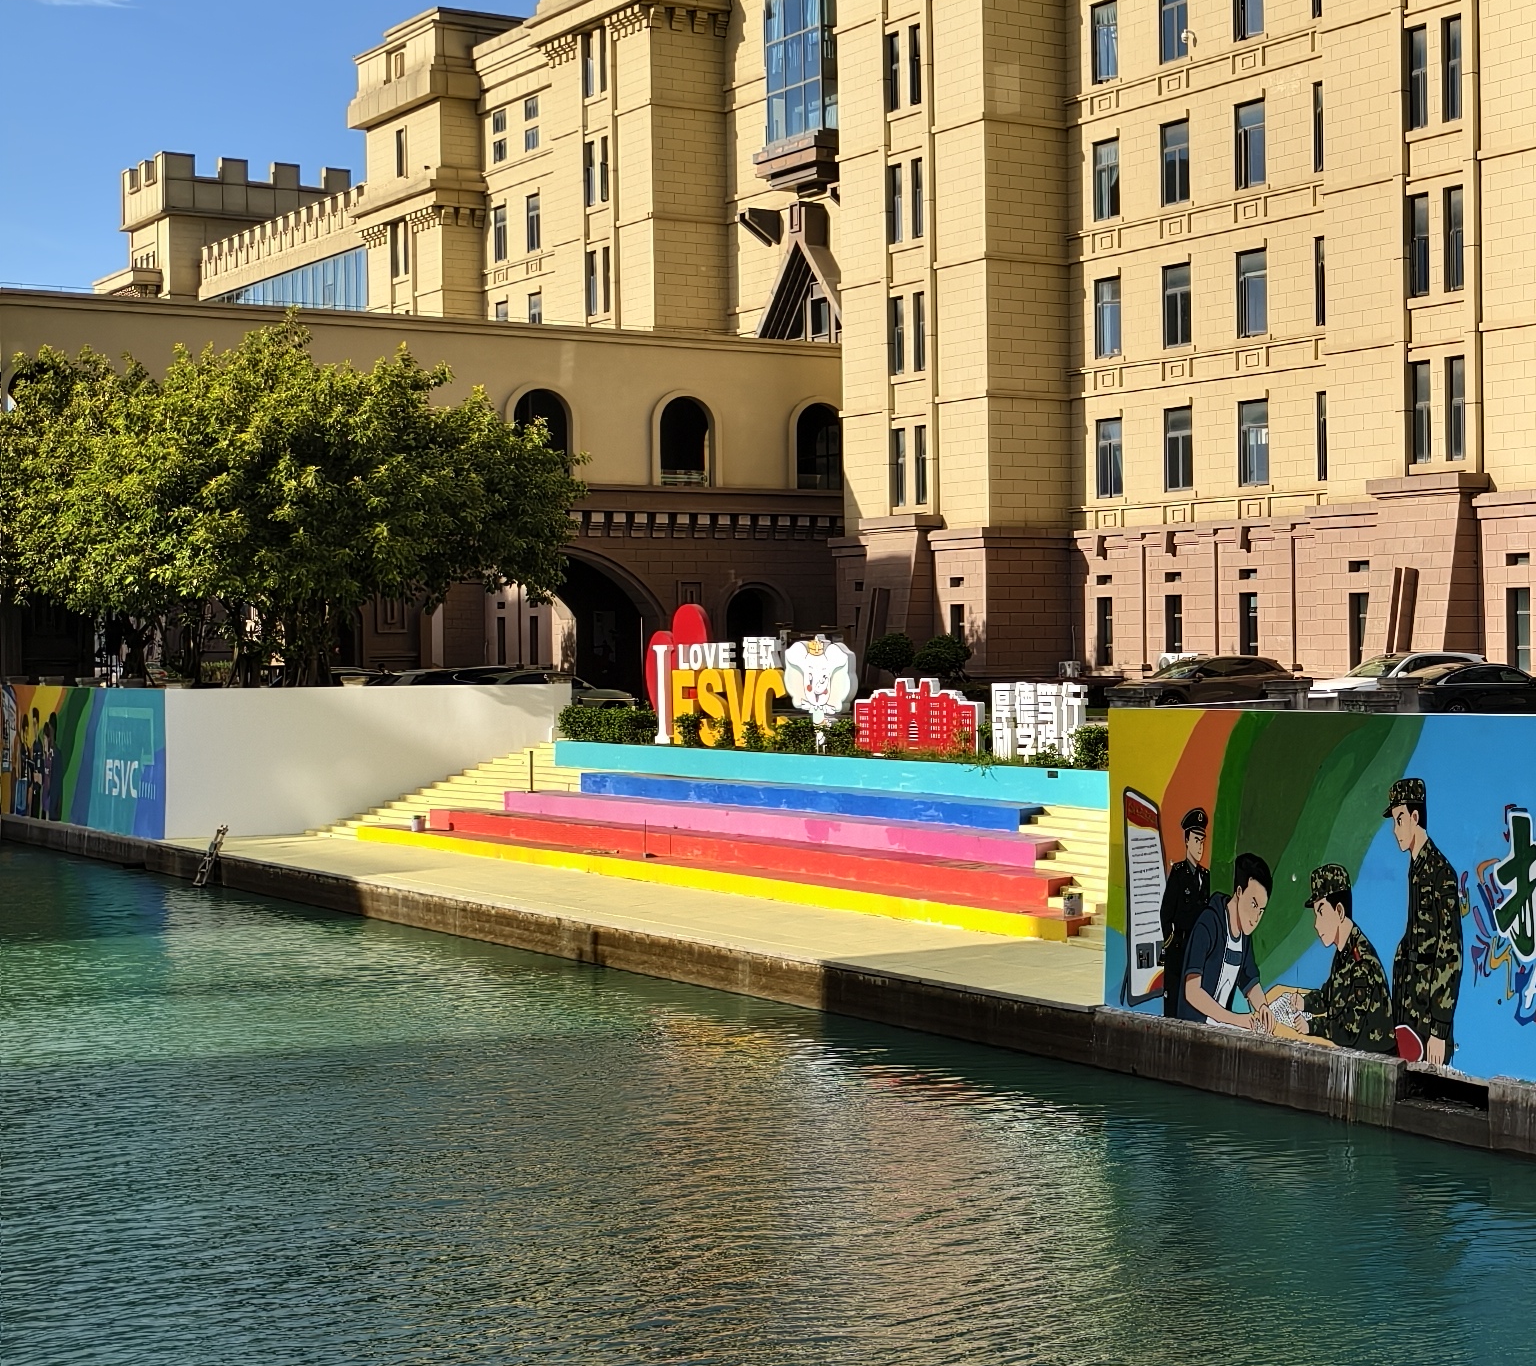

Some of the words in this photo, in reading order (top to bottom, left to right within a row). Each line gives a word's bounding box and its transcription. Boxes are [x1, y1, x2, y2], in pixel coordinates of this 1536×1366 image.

[678, 642, 736, 669] LOVE
[672, 668, 791, 747] FSVC
[104, 758, 139, 799] FSVC
